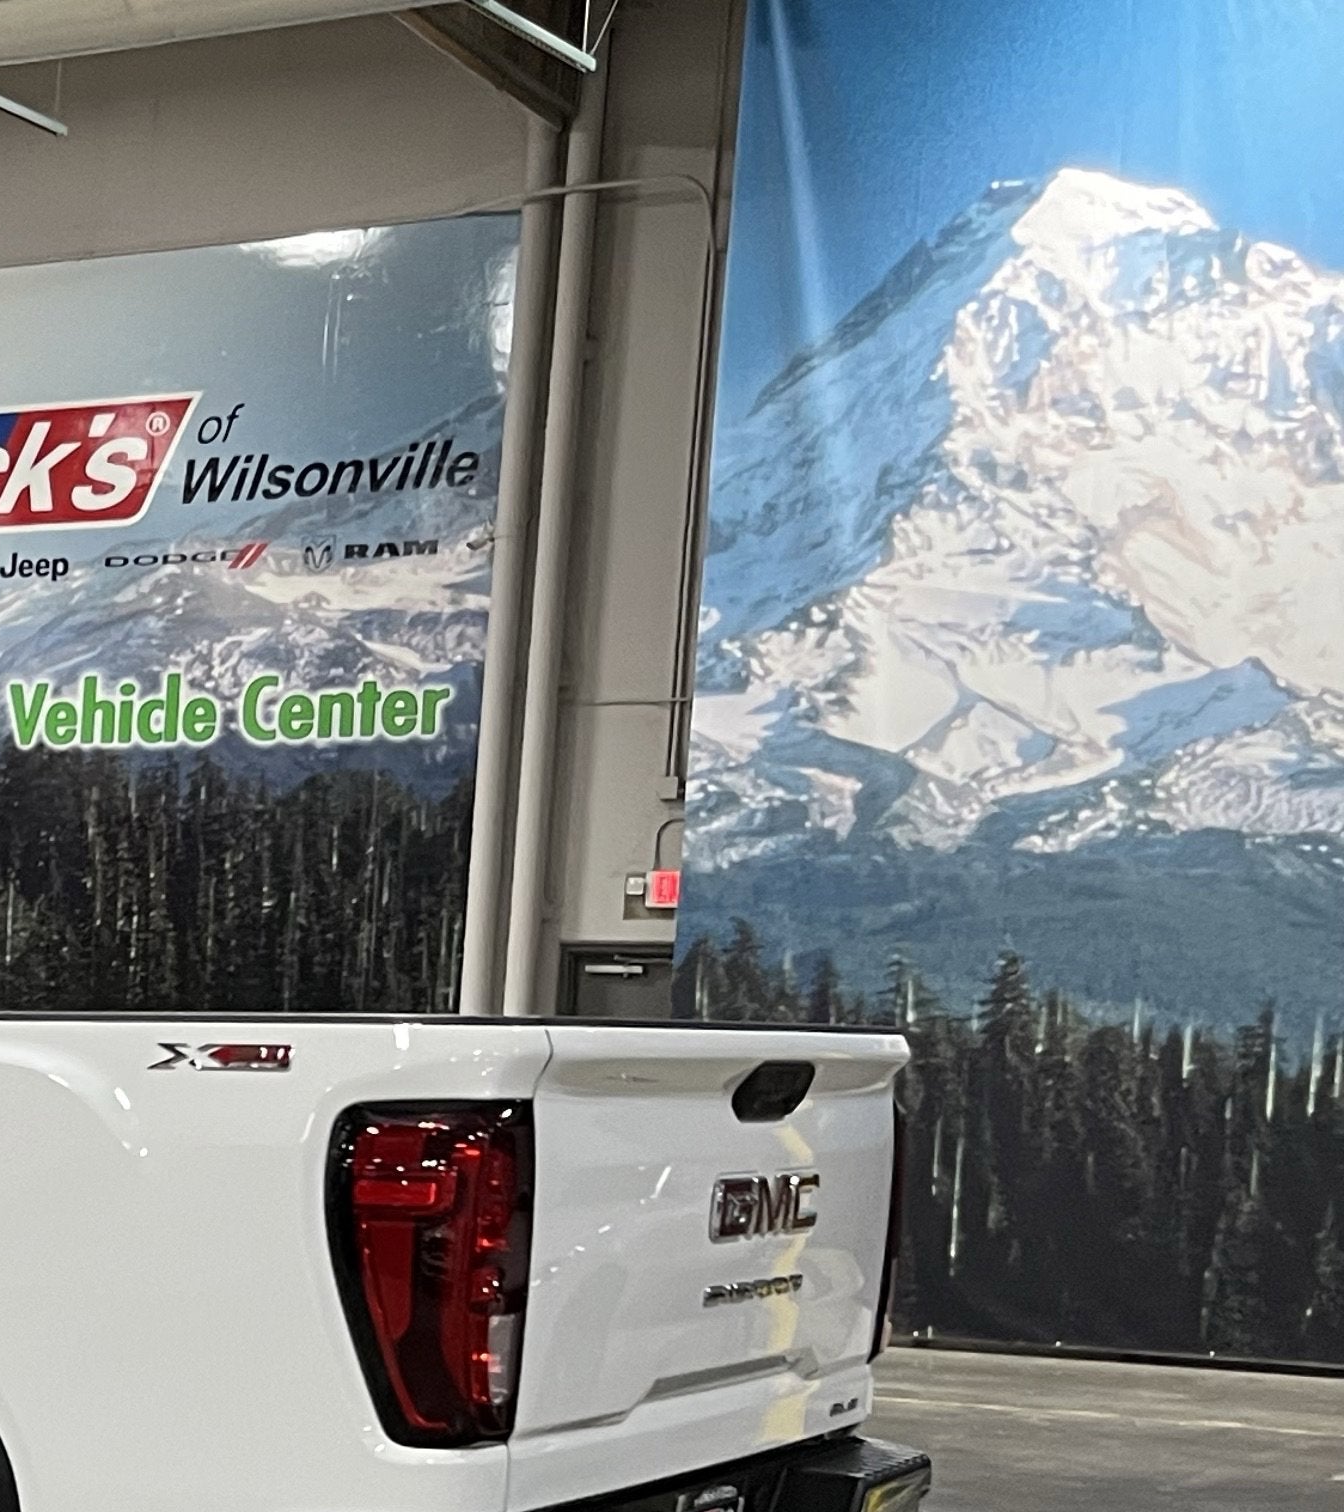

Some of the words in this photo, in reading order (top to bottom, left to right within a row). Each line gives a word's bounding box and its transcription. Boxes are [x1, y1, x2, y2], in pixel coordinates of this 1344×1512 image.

[197, 403, 245, 445] of
[181, 439, 481, 505] Wilsonville
[0, 552, 70, 582] Jeep
[103, 550, 240, 568] DODGE
[344, 539, 440, 560] RAM
[10, 672, 217, 746] Vehicle
[242, 675, 450, 742] Center
[709, 1171, 821, 1243] GMC
